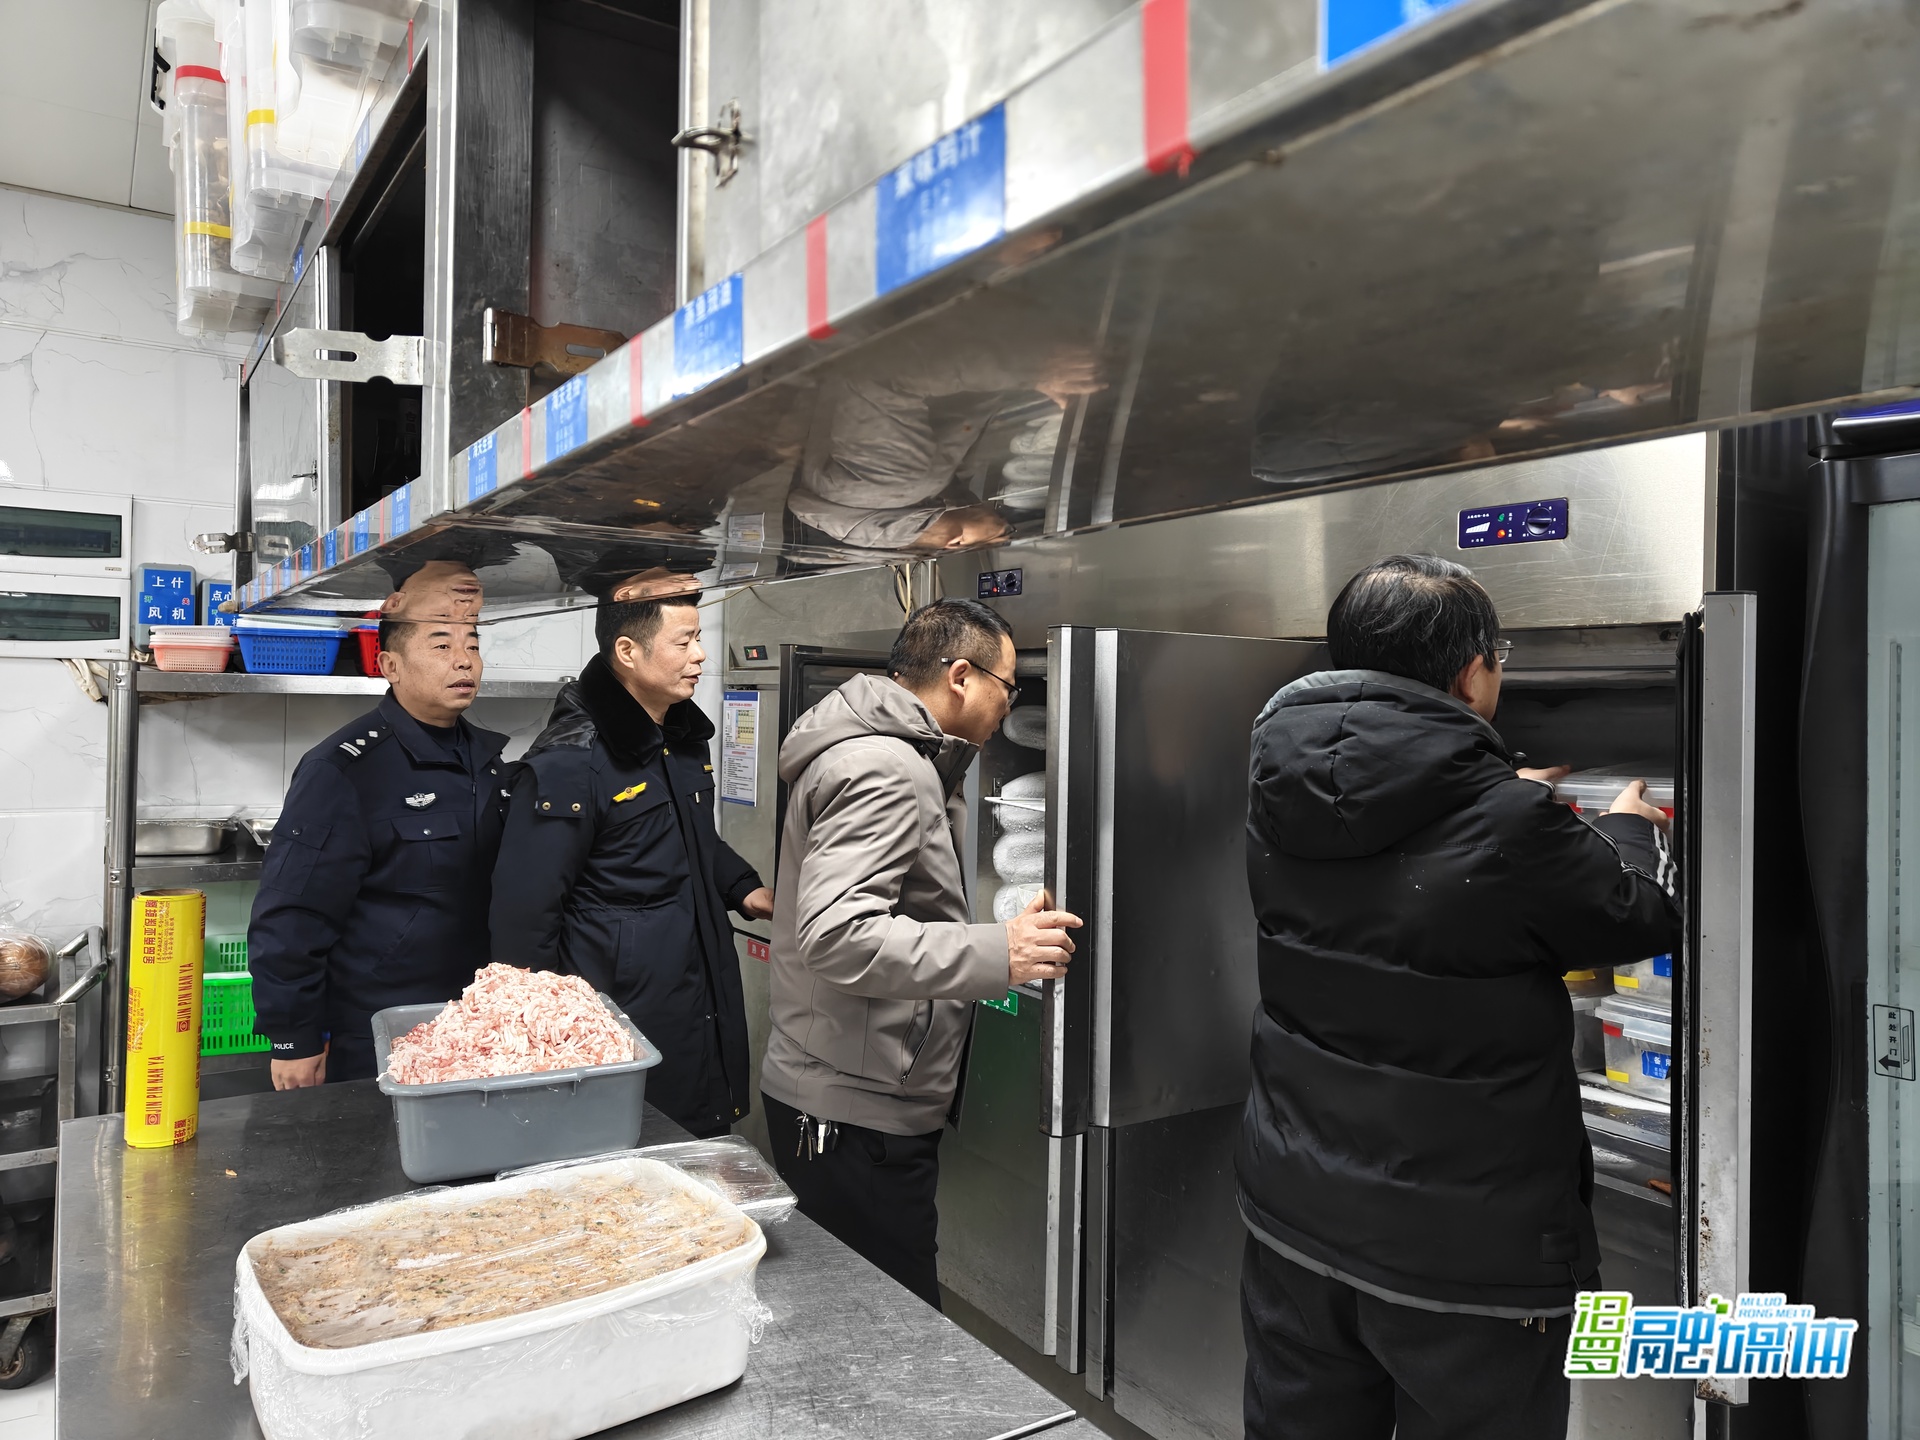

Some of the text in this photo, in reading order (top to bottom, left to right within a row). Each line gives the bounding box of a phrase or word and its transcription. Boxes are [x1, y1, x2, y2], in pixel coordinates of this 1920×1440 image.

[152, 576, 184, 589] 上什
[211, 590, 232, 602] 点心
[148, 606, 186, 620] 风机
[143, 900, 158, 964] 金品南亚保鲜膜
[177, 962, 194, 1020] JIN PIN NAN YA
[273, 1042, 294, 1050] POLICE
[1888, 1011, 1897, 1056] 此处开门
[145, 1055, 165, 1113] JIN PIN NAN YA
